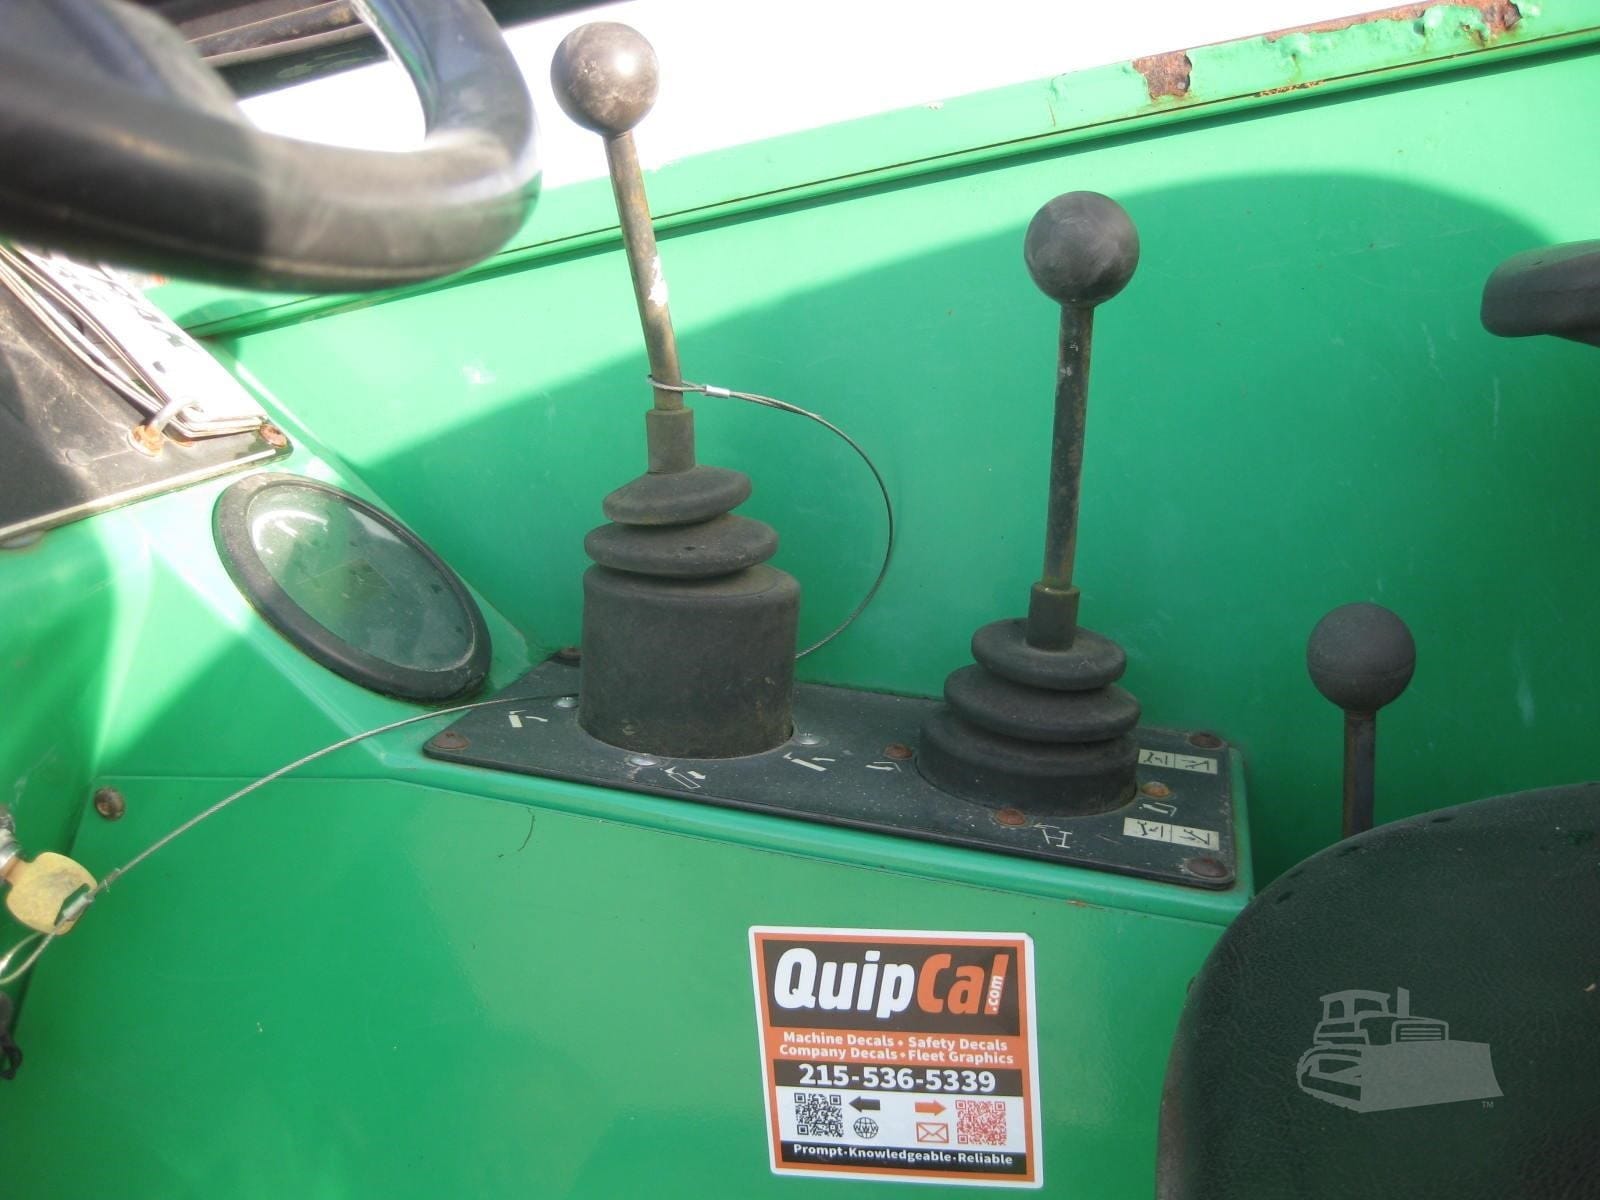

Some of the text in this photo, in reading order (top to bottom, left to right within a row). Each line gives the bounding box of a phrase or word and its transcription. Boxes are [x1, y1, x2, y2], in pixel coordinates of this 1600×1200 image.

[774, 947, 1010, 1019] QuipCal
[989, 975, 1004, 1012] .com
[779, 1044, 1014, 1066] Company Decals Fleet Graphics
[783, 1031, 1008, 1051] Machine Decals Safety Decals
[798, 1063, 996, 1093] 215-536-5339
